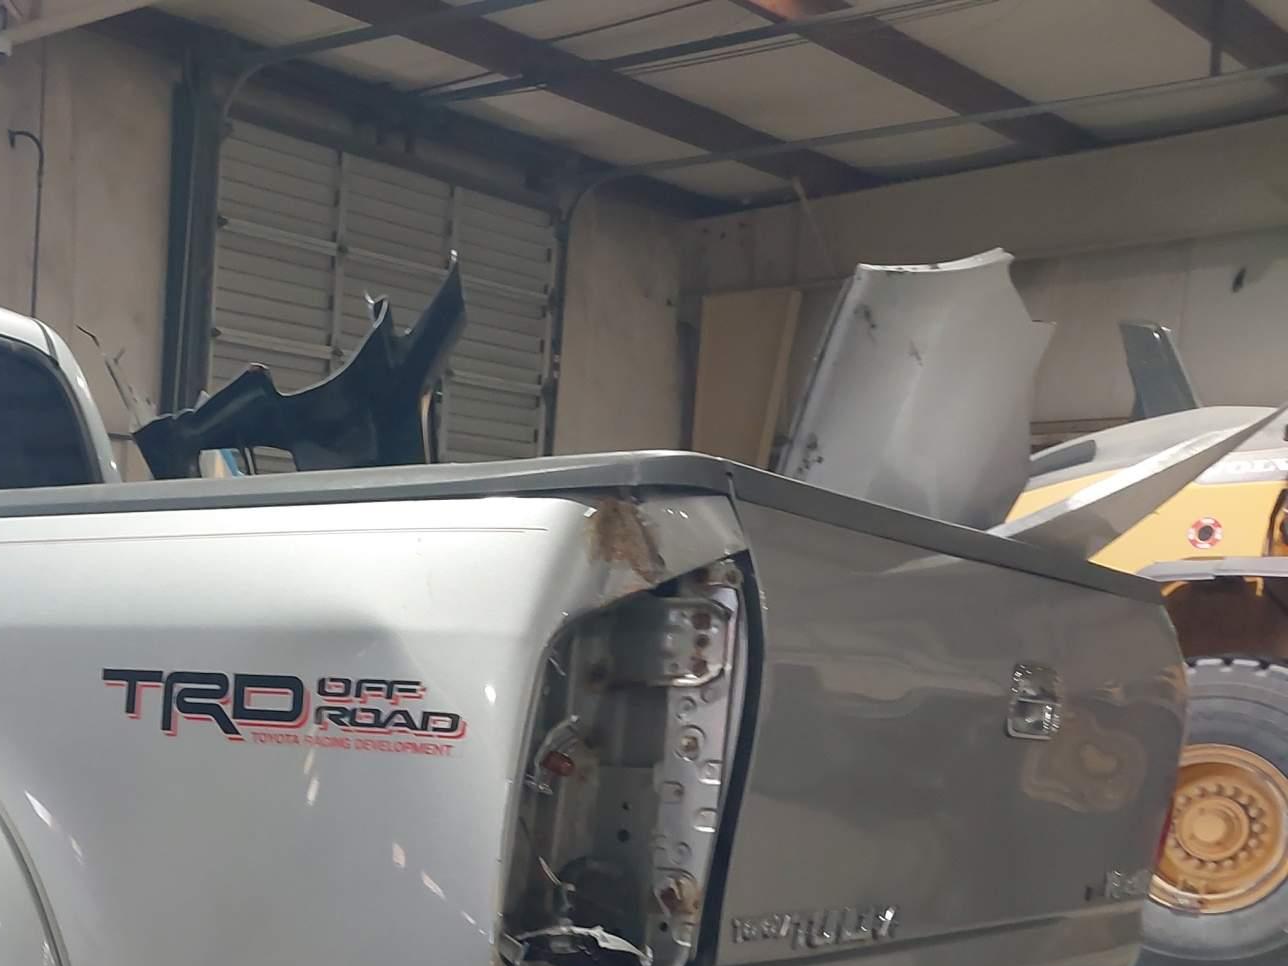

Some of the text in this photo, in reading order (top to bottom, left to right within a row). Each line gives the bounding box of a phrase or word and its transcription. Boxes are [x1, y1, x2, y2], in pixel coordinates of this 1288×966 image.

[102, 668, 309, 741] TRD
[316, 677, 425, 705] OFF
[315, 705, 467, 739] ROAD
[251, 731, 300, 745] TOYOTA
[354, 738, 455, 757] DEVELOPMENT
